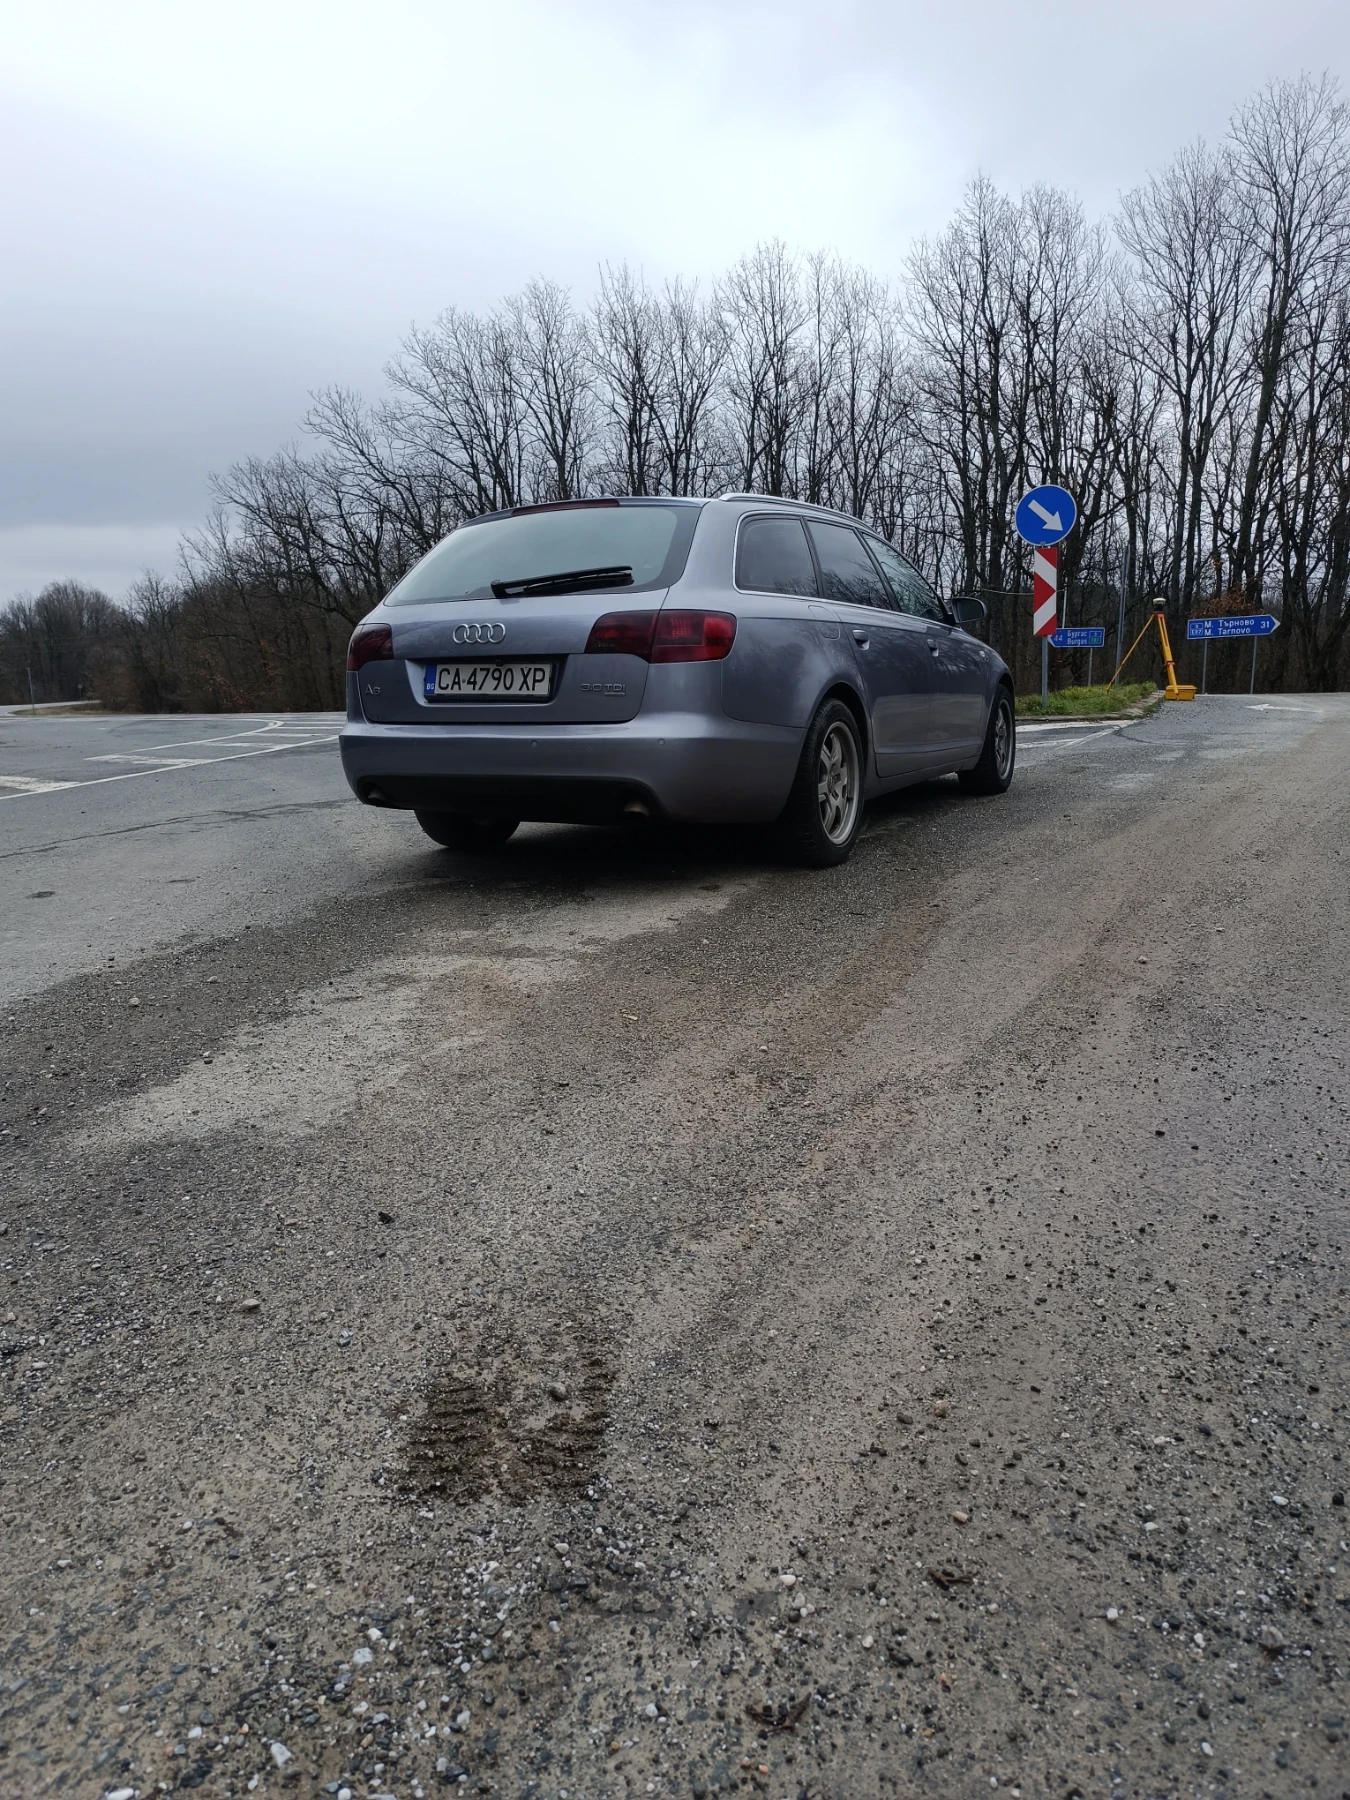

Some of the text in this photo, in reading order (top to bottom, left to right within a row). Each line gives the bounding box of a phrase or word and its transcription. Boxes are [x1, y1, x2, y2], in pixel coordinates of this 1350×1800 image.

[1218, 619, 1255, 628] Търново
[1260, 620, 1270, 629] 31
[1067, 630, 1087, 638] Бургас
[1218, 627, 1251, 635] Tarnovo
[1067, 638, 1087, 646] Burgas
[365, 683, 381, 695] A6
